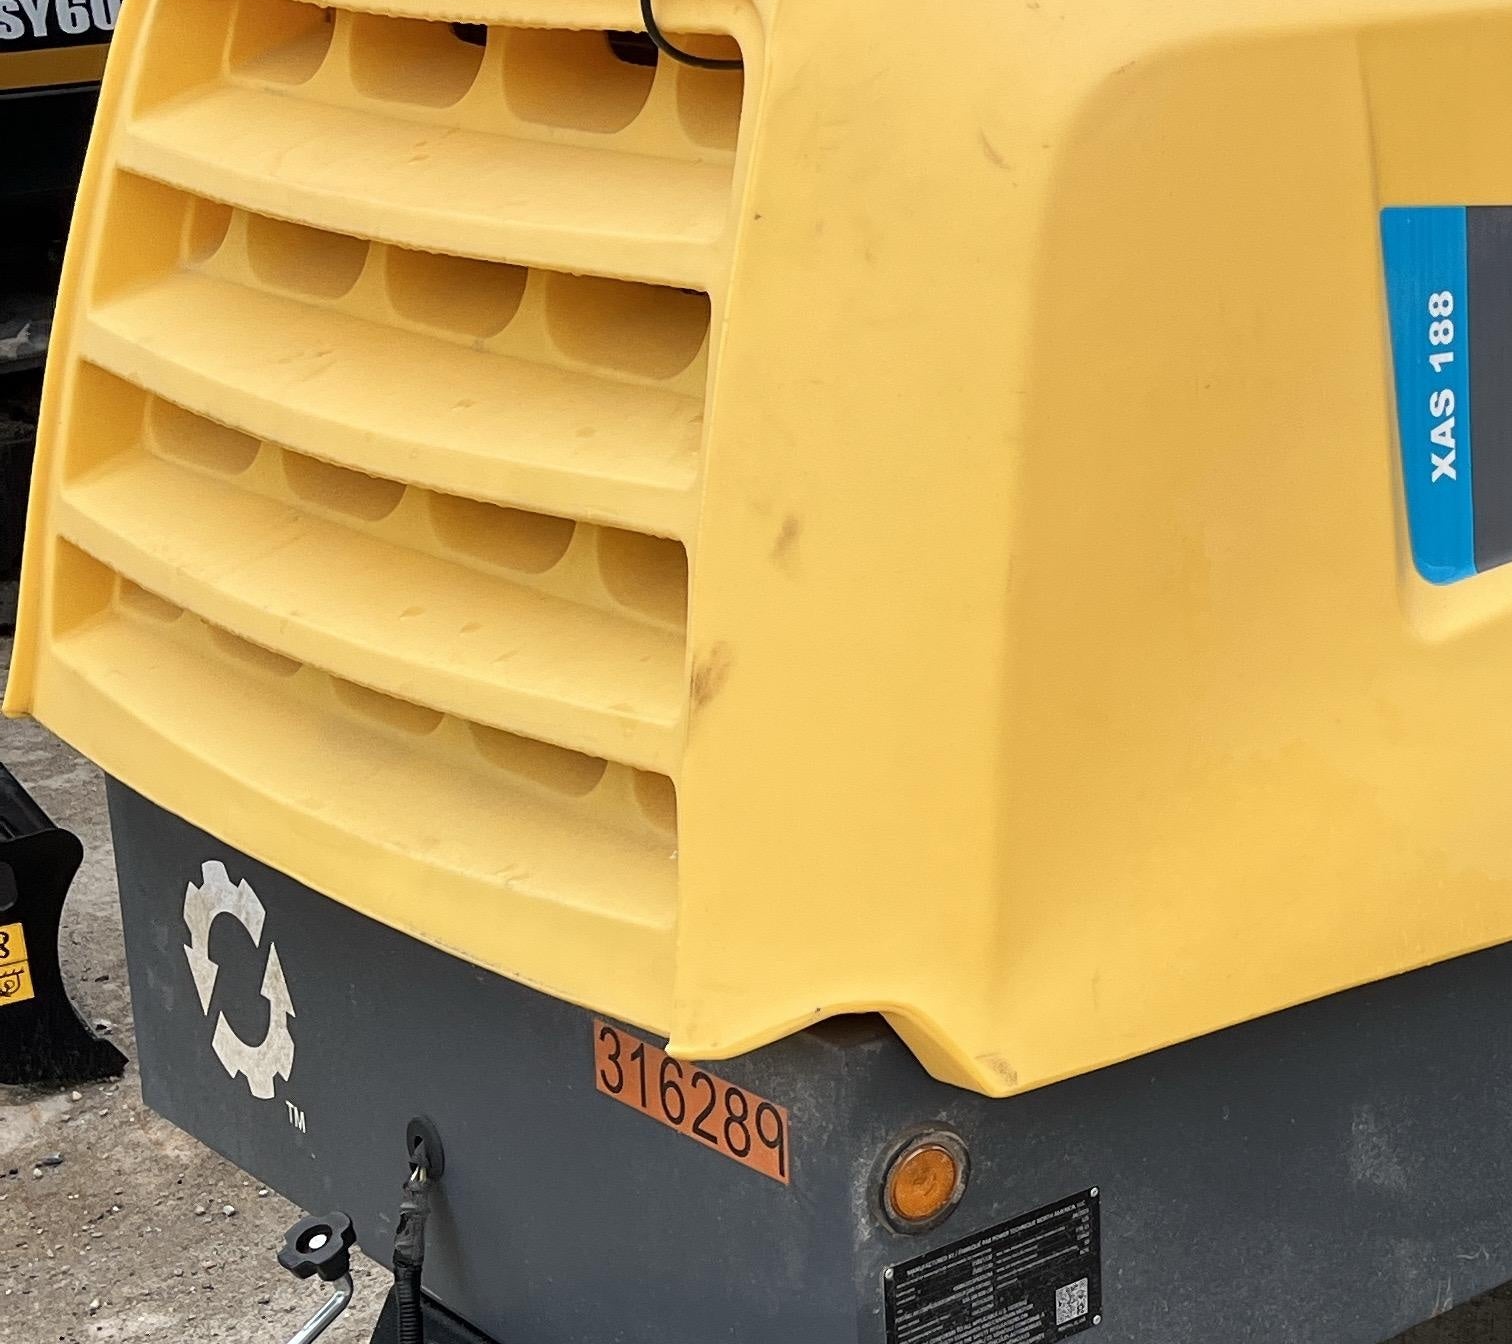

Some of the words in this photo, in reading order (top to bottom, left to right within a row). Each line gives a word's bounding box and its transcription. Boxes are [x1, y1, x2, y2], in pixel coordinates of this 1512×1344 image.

[1428, 290, 1455, 373] 188
[1429, 388, 1457, 484] XAS
[600, 1026, 786, 1179] 316289
